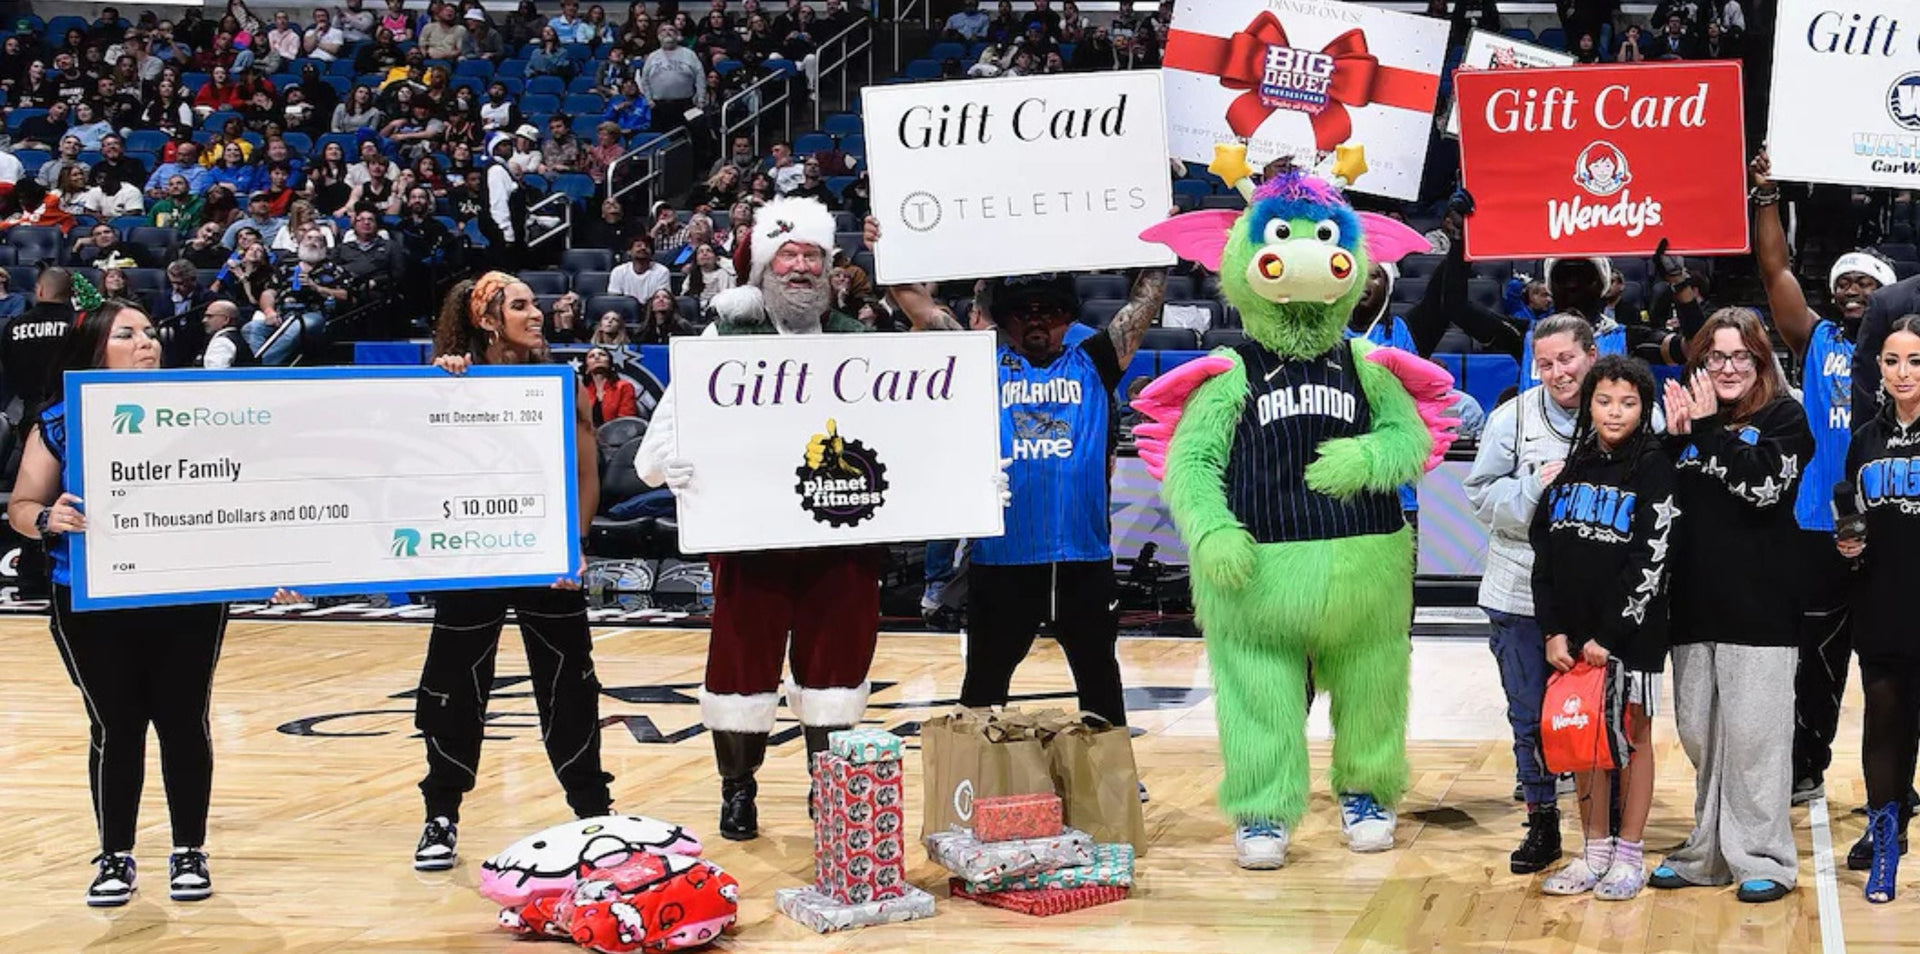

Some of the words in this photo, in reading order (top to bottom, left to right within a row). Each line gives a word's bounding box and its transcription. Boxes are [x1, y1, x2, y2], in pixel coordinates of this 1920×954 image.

[1807, 11, 1901, 57] Gift
[1266, 46, 1335, 78] BIG
[1486, 86, 1579, 133] Gift
[1594, 83, 1709, 130] Card
[899, 103, 994, 149] Gift
[1012, 94, 1127, 142] Card
[1853, 132, 1920, 158] WAT
[1871, 160, 1920, 174] CarW
[954, 187, 1147, 219] TELETIES
[1548, 189, 1661, 240] Wendy's
[12, 321, 68, 341] SECURIT
[708, 359, 814, 407] Gift
[833, 355, 957, 404] Card
[1002, 378, 1082, 409] ORLANDO
[156, 407, 272, 428] ReRoute
[429, 413, 450, 424] DATE
[454, 411, 500, 423] December
[520, 410, 543, 422] 2024
[1258, 384, 1356, 427] ORLANDO
[111, 461, 172, 482] Butler
[178, 458, 242, 482] Family
[803, 475, 868, 497] planet
[812, 491, 881, 507] fitness
[112, 513, 140, 529] Ten
[144, 510, 213, 528] Thousand
[217, 507, 266, 524] Dollars
[270, 506, 296, 522] and
[299, 503, 350, 521] 00/100
[443, 500, 451, 519] $
[431, 530, 537, 549] ReRoute
[112, 563, 137, 571] FOR
